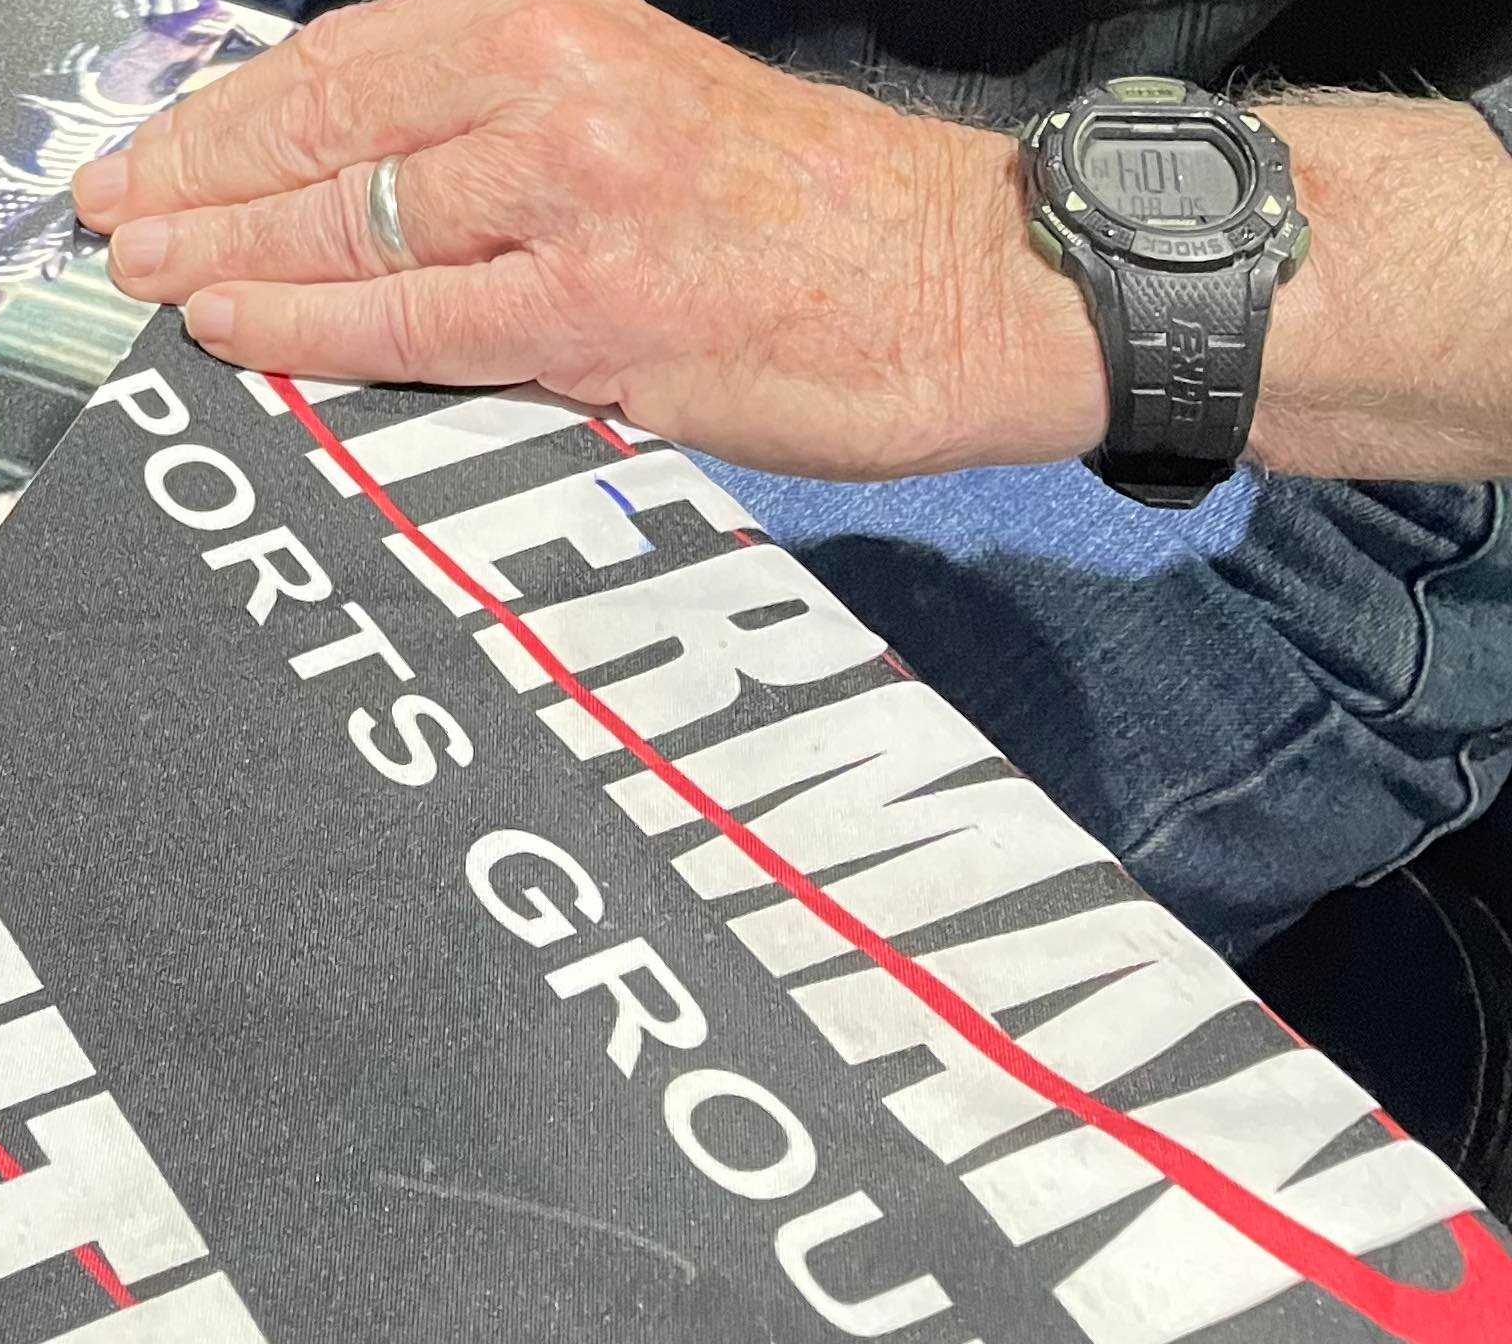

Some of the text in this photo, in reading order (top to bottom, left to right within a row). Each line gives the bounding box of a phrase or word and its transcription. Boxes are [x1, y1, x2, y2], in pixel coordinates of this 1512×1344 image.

[1141, 235, 1224, 257] SHOCK
[87, 366, 988, 1344] PORTS GROU
